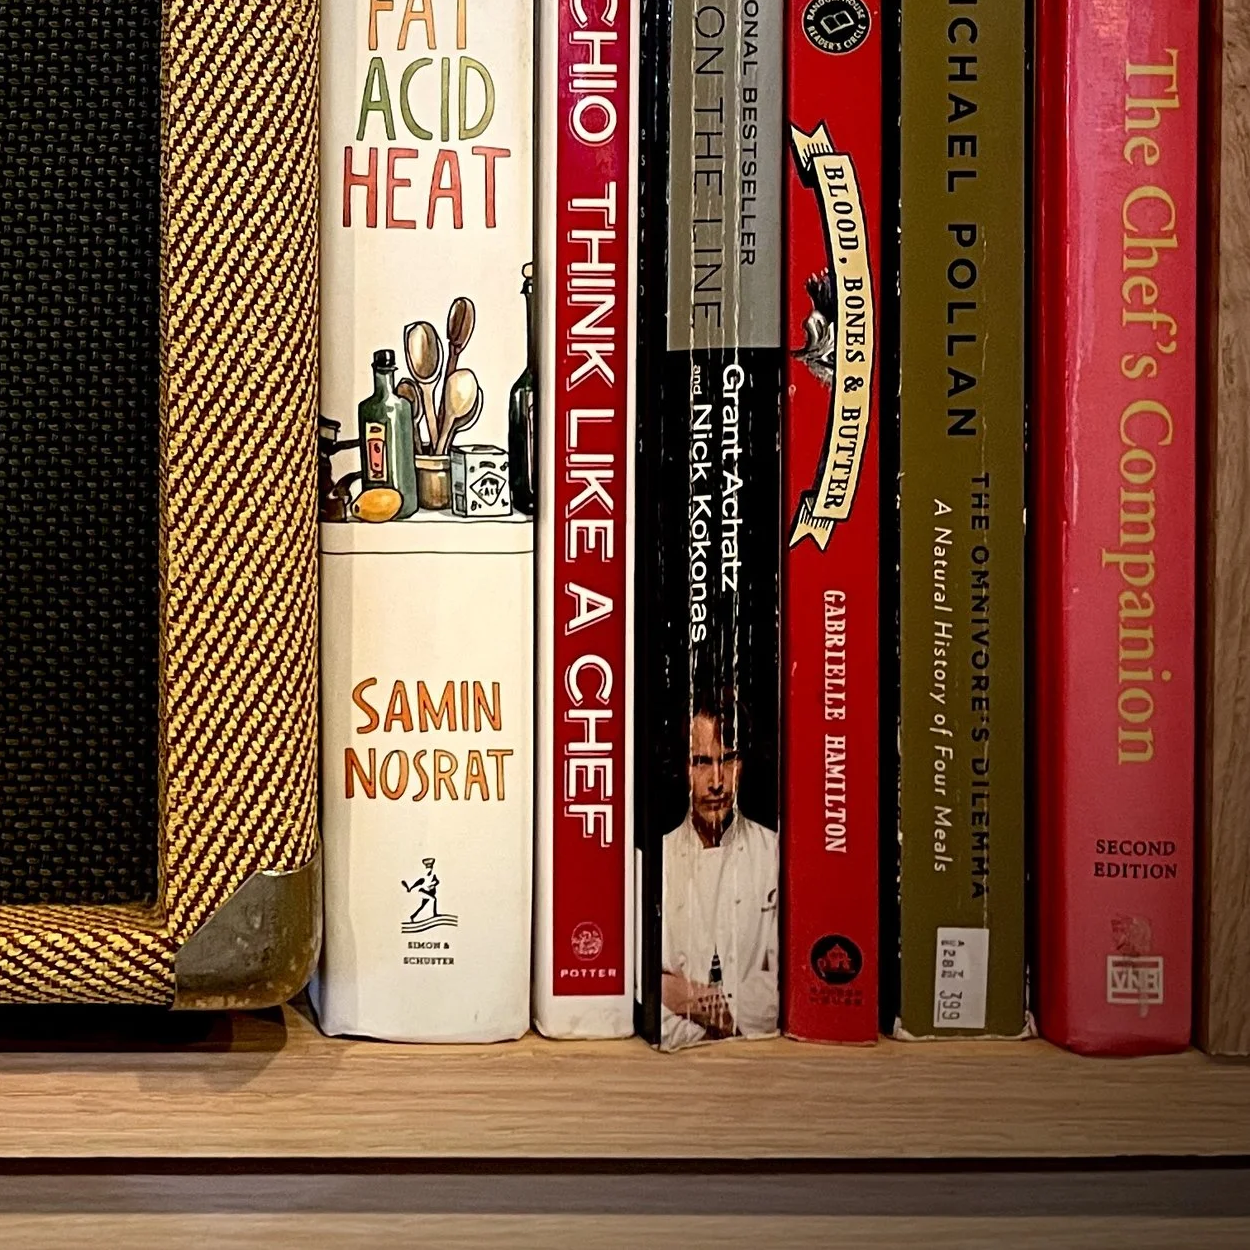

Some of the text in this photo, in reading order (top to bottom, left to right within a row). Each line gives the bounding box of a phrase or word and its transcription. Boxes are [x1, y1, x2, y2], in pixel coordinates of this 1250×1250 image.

[694, 5, 725, 75] ON
[807, 24, 867, 51] READER'S CIRCLE
[355, 56, 495, 142] ACID
[693, 97, 724, 196] THE
[341, 146, 511, 230] HEAT
[739, 87, 758, 266] BESTSELLER
[565, 181, 617, 393] THINK
[691, 219, 722, 328] LINE
[823, 163, 865, 510] BLOOD, BONES & BUTTER
[947, 224, 979, 437] POLLAN
[1101, 49, 1180, 765] The Chef's Companion
[563, 412, 615, 563] LIKE
[691, 364, 713, 643] and Nick Kokonas
[721, 364, 745, 593] Grant Achatz
[563, 583, 614, 635] A
[352, 676, 502, 735] SAMIN
[824, 589, 847, 853] GABRIELLE HAMILTON
[930, 498, 954, 872] A Natural History of Four Meals
[971, 472, 990, 899] THE OMNIVORE'S DILEMMA
[344, 747, 513, 803] NOSRAT
[563, 654, 614, 848] CHEF
[1093, 861, 1178, 879] EDITION
[1095, 839, 1176, 856] SECOND
[560, 968, 617, 978] POTTER
[939, 989, 963, 1020] 399
